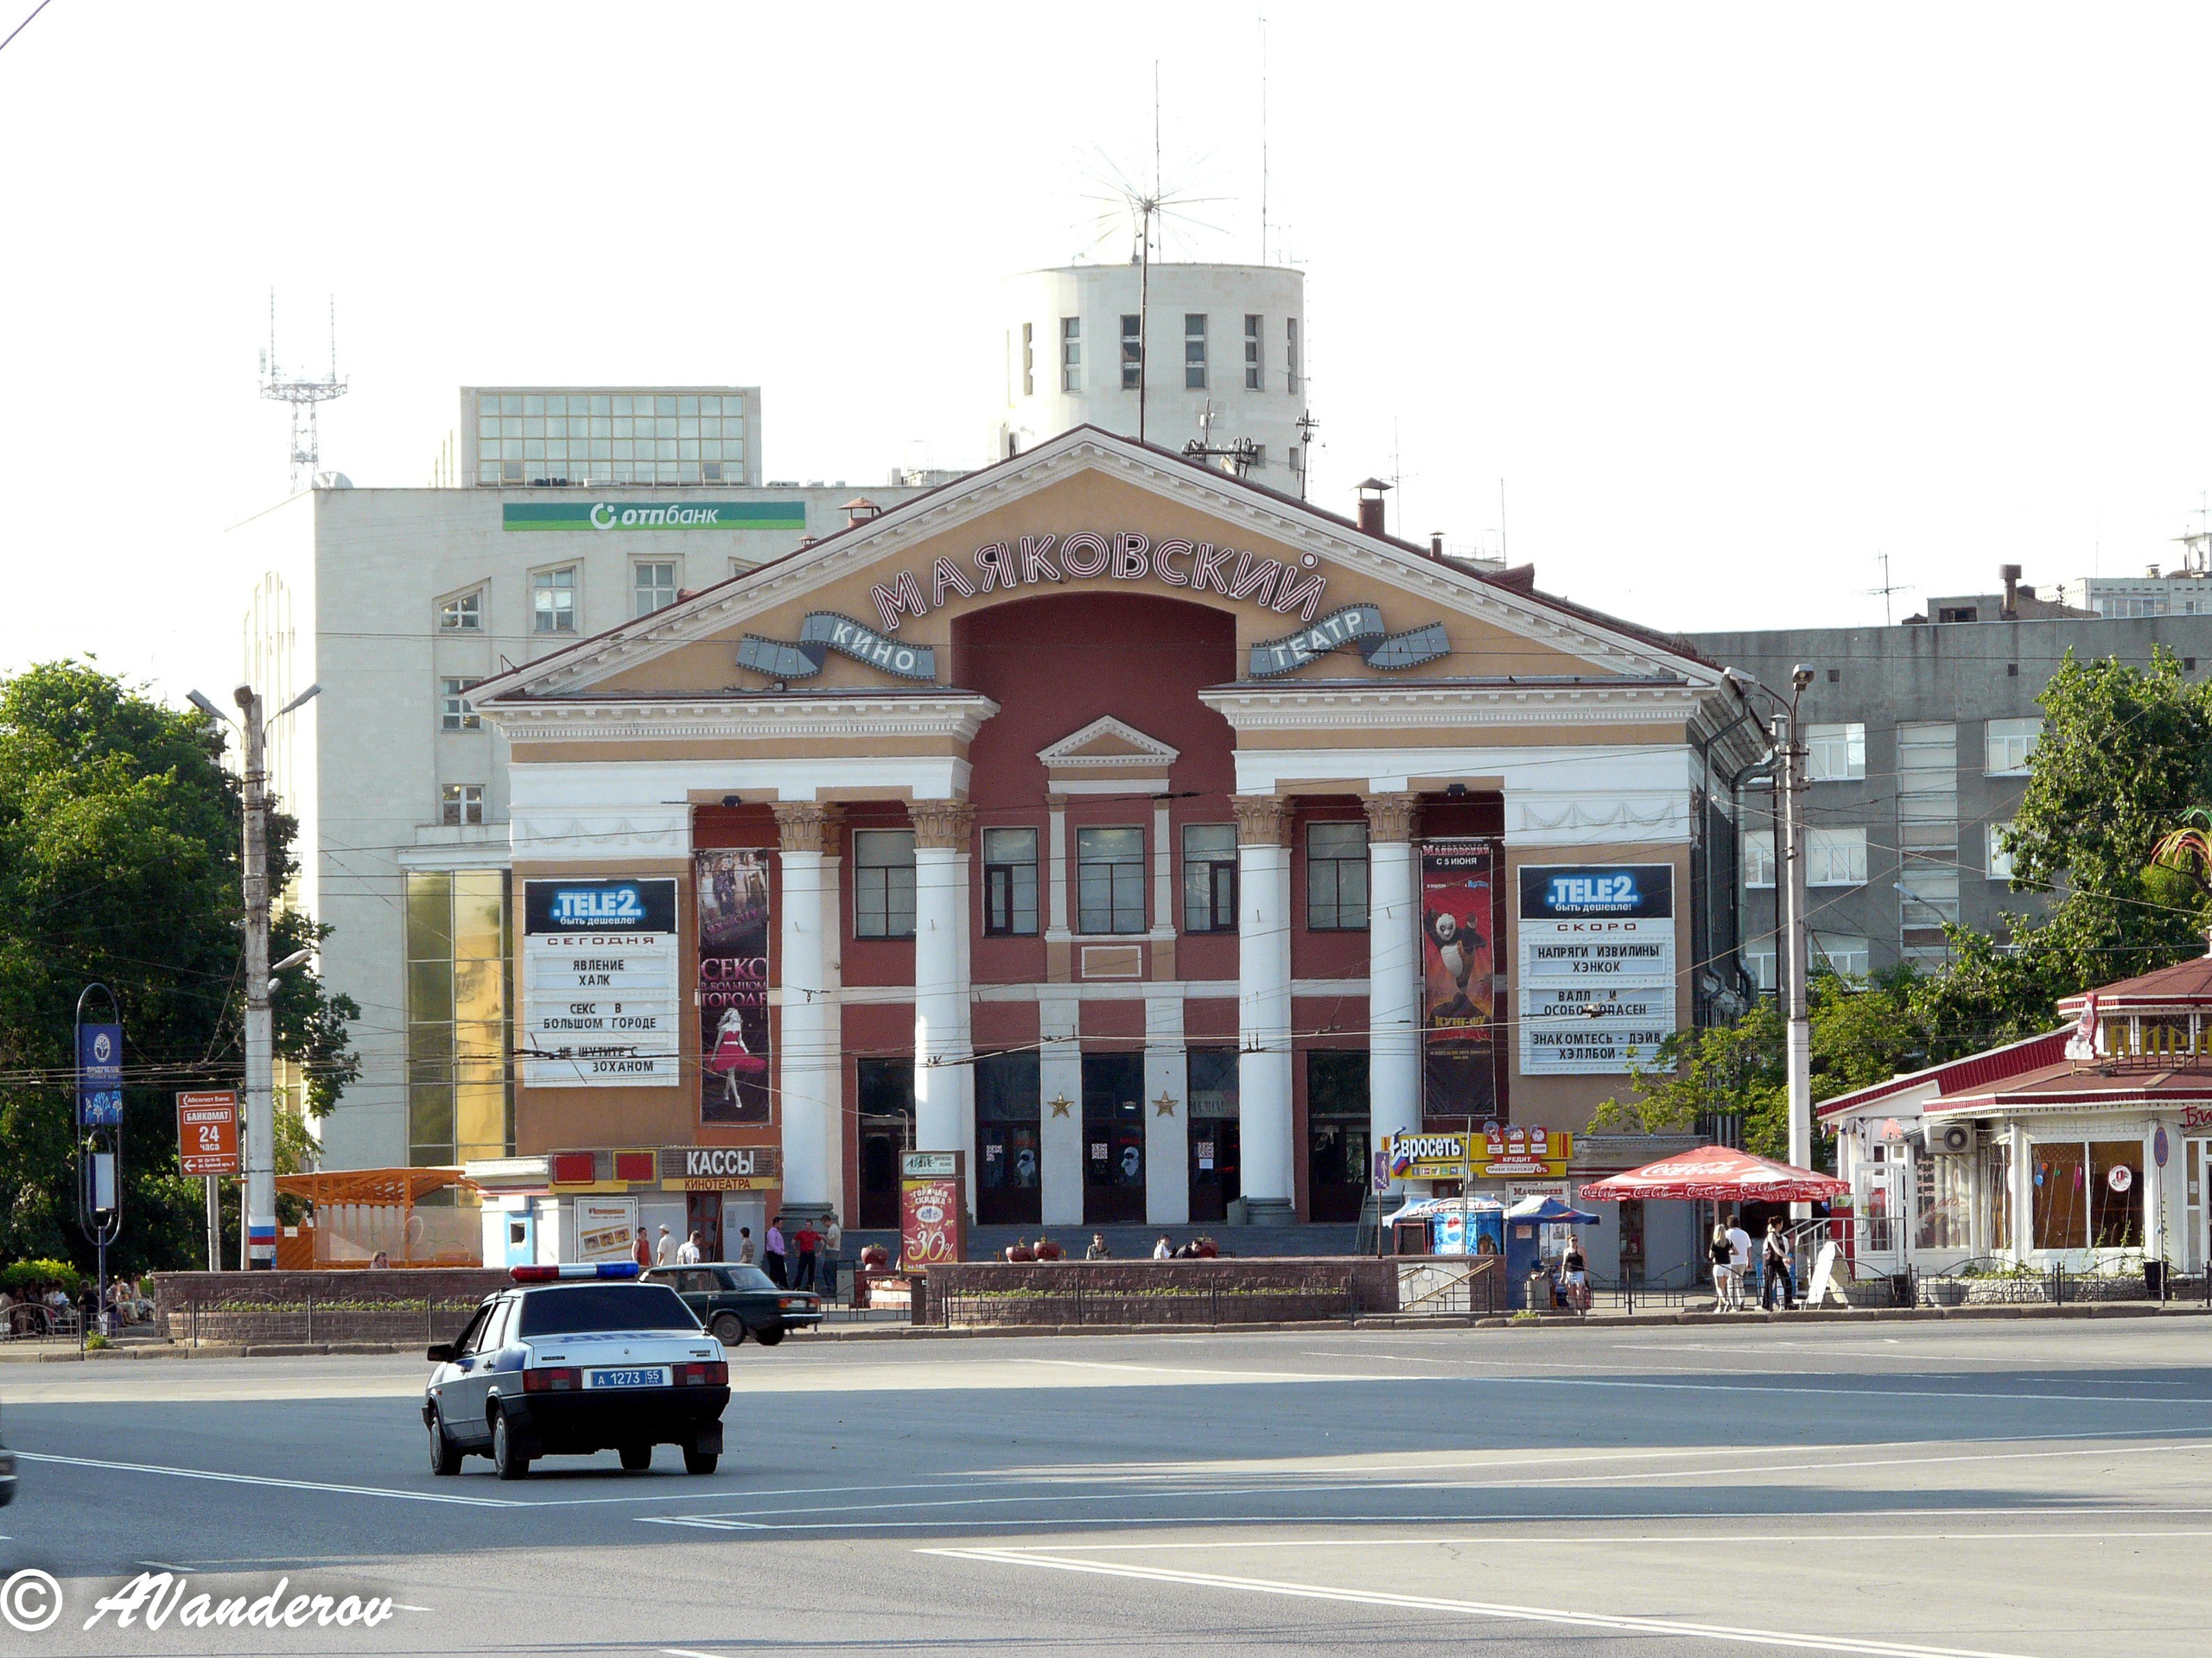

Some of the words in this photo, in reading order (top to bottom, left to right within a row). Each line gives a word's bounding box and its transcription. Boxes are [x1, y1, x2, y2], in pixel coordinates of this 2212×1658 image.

[871, 531, 1325, 630] МАЯКОВСКИЙ
[1270, 611, 1362, 666] ТЕАТР
[832, 622, 914, 670] КИНО
[1555, 903, 1580, 912] быть
[1583, 903, 1631, 912] дешевле!
[560, 917, 585, 925] быть
[588, 917, 635, 925] дешевле!
[1557, 923, 1637, 931] СКОРО
[1538, 947, 1589, 958] НАПРЯГИ
[1597, 945, 1660, 957] ИЗВИЛИНЫ
[573, 960, 624, 971] ЯВЛЕНИЕ
[701, 957, 766, 981] СЕКС
[1573, 962, 1620, 973] ХЭНКОК
[579, 975, 611, 986] ХАЛК
[710, 981, 766, 991] БОЛЬШОМ
[702, 992, 766, 1007] ГОРОДЕ
[1558, 991, 1591, 1001] ВАЛЛ
[569, 1003, 596, 1014] СЕКС
[614, 1003, 622, 1013] В
[1544, 1005, 1584, 1015] ОСОБО
[1599, 1004, 1647, 1015] ОПАСЕН
[543, 1018, 603, 1029] БОЛЬШОМ
[612, 1018, 657, 1029] ГОРОДЕ
[1533, 1033, 1613, 1045] ЗНАКОМТЕСЬ
[1629, 1032, 1661, 1045] ДЭЙВ
[579, 1046, 625, 1057] ШУТИТЕ
[593, 1061, 654, 1072] ЗОХАНОМ
[186, 1111, 229, 1121] БАНКОМАТ
[199, 1125, 219, 1143] 24
[200, 1143, 220, 1152] часа
[687, 1150, 754, 1175] КАССЫ
[684, 1178, 751, 1190] КИНОТЕАТРА
[912, 1188, 949, 1199] ГОРЯЧАЯ
[915, 1196, 946, 1205] СКИДКА
[610, 1372, 639, 1384] 1273
[647, 1370, 659, 1380] 55
